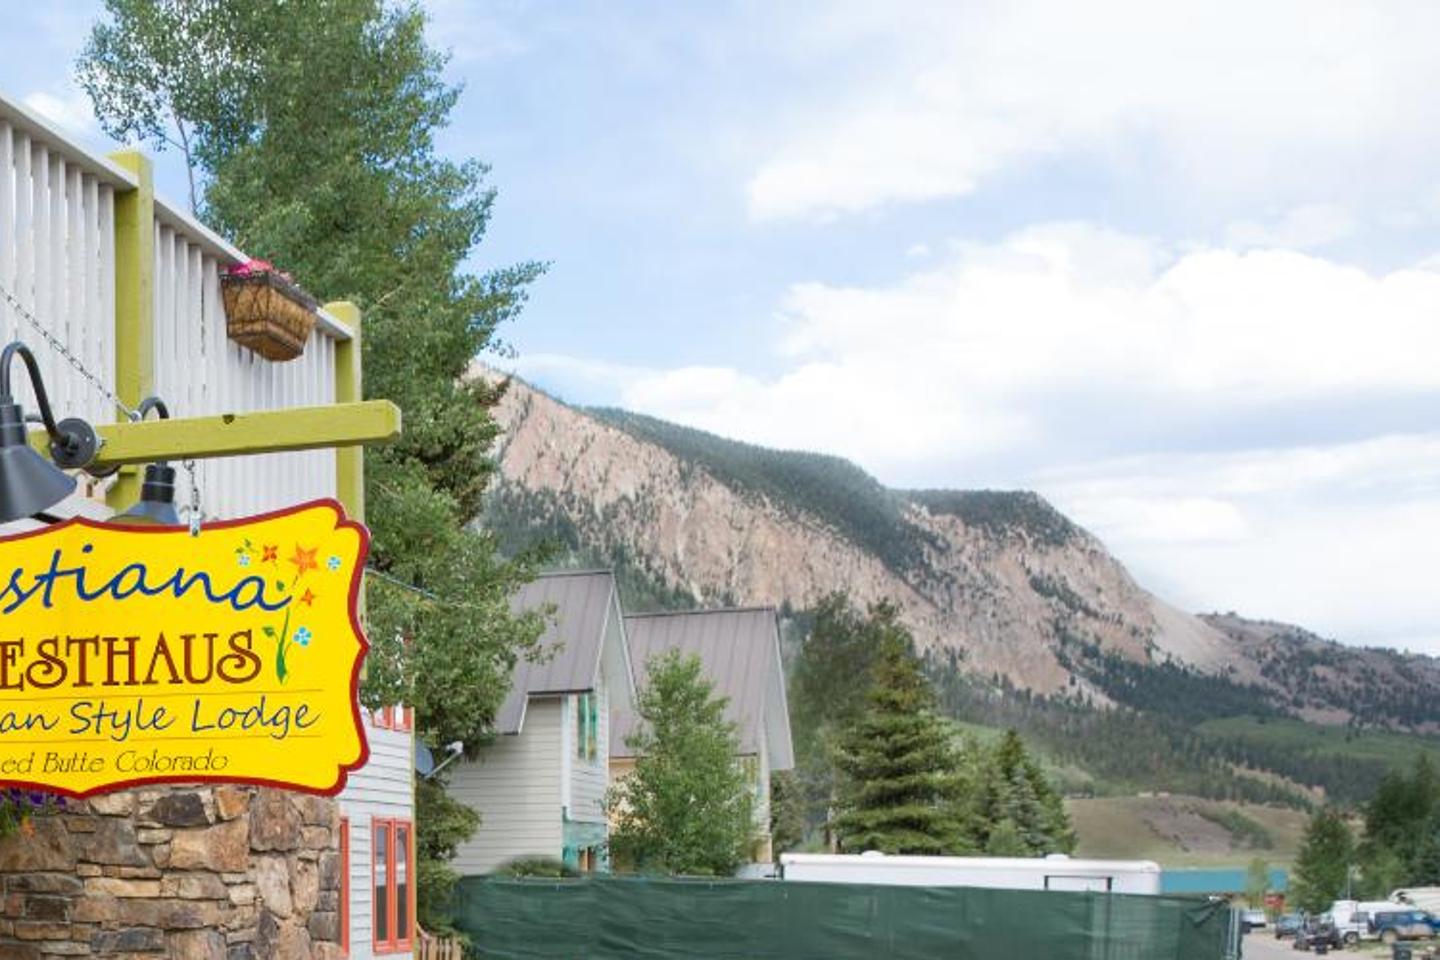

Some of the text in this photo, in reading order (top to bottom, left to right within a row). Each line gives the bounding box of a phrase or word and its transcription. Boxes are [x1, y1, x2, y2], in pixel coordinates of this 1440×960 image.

[68, 698, 175, 741] Style
[191, 695, 320, 740] Lodge
[42, 750, 105, 774] Butte
[115, 747, 228, 773] Colorado
